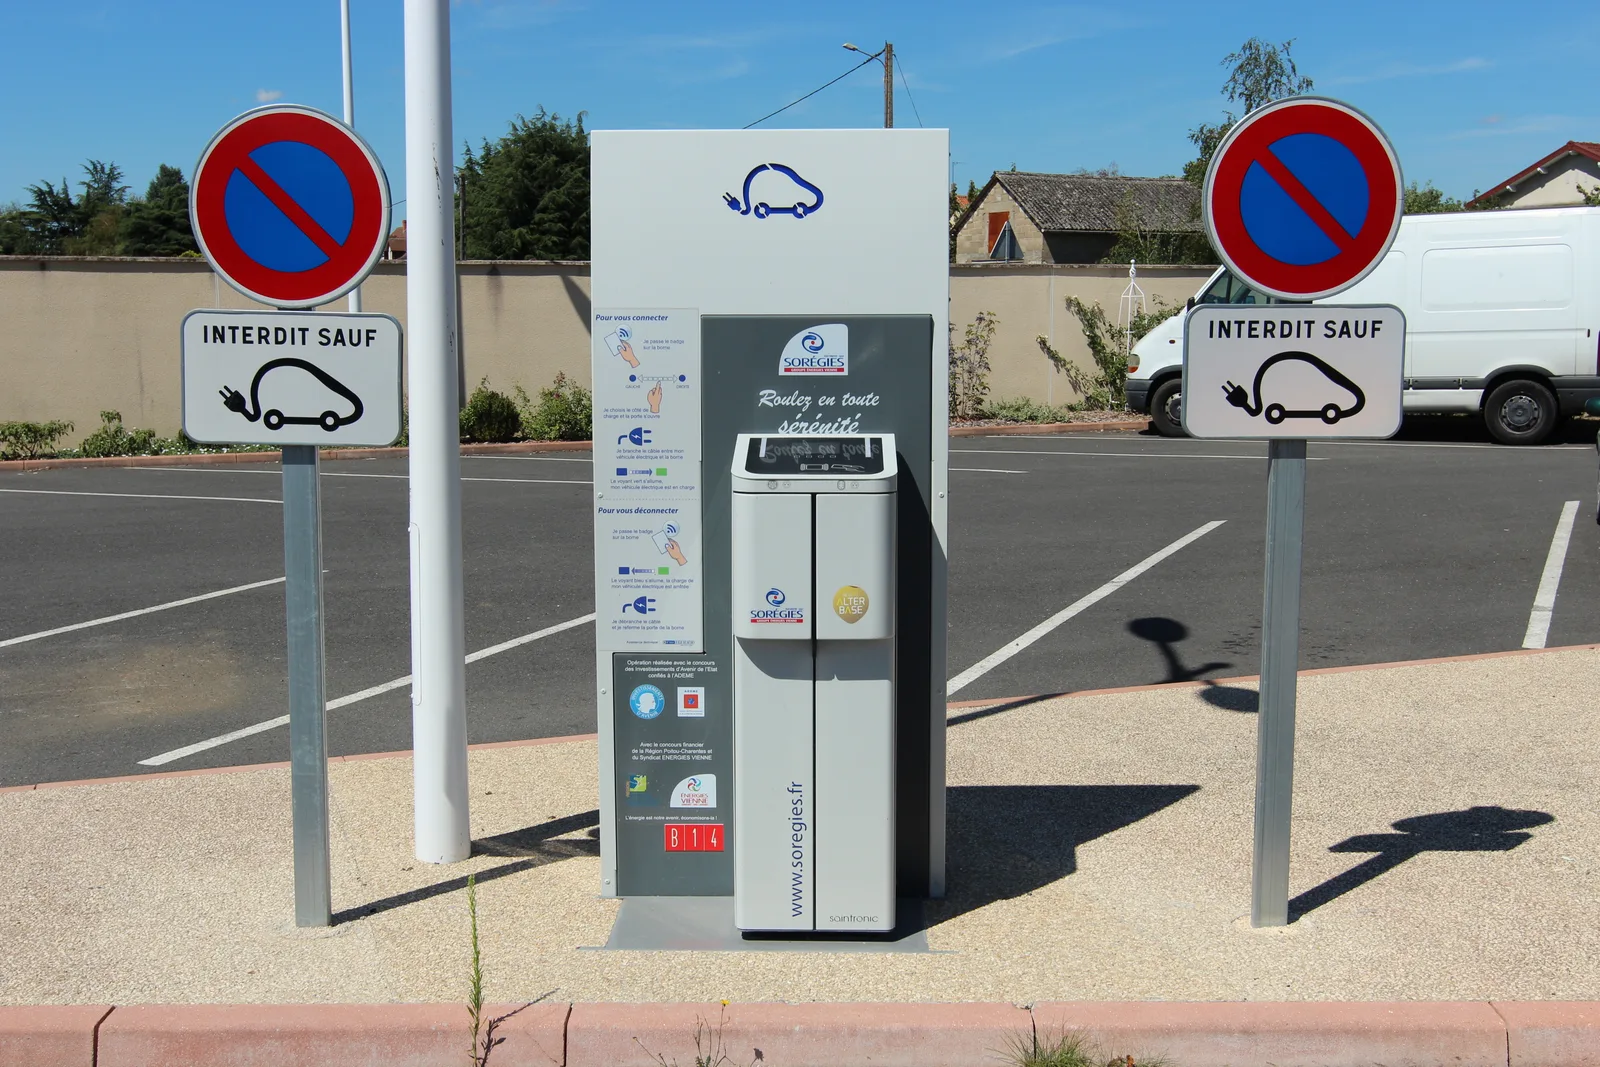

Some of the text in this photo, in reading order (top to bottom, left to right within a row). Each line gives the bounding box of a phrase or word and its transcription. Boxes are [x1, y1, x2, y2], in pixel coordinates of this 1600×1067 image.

[203, 325, 377, 347] INTERDIT SAUF
[1209, 320, 1383, 338] INTERDIT SAUF
[784, 356, 844, 367] SORÉGIES
[758, 389, 880, 411] Roulez en toute
[778, 413, 861, 434] sérénité
[837, 597, 865, 605] ALTER
[839, 606, 863, 614] BASE
[750, 609, 803, 618] SORÉGIES
[787, 781, 807, 917] www.soregies.fr
